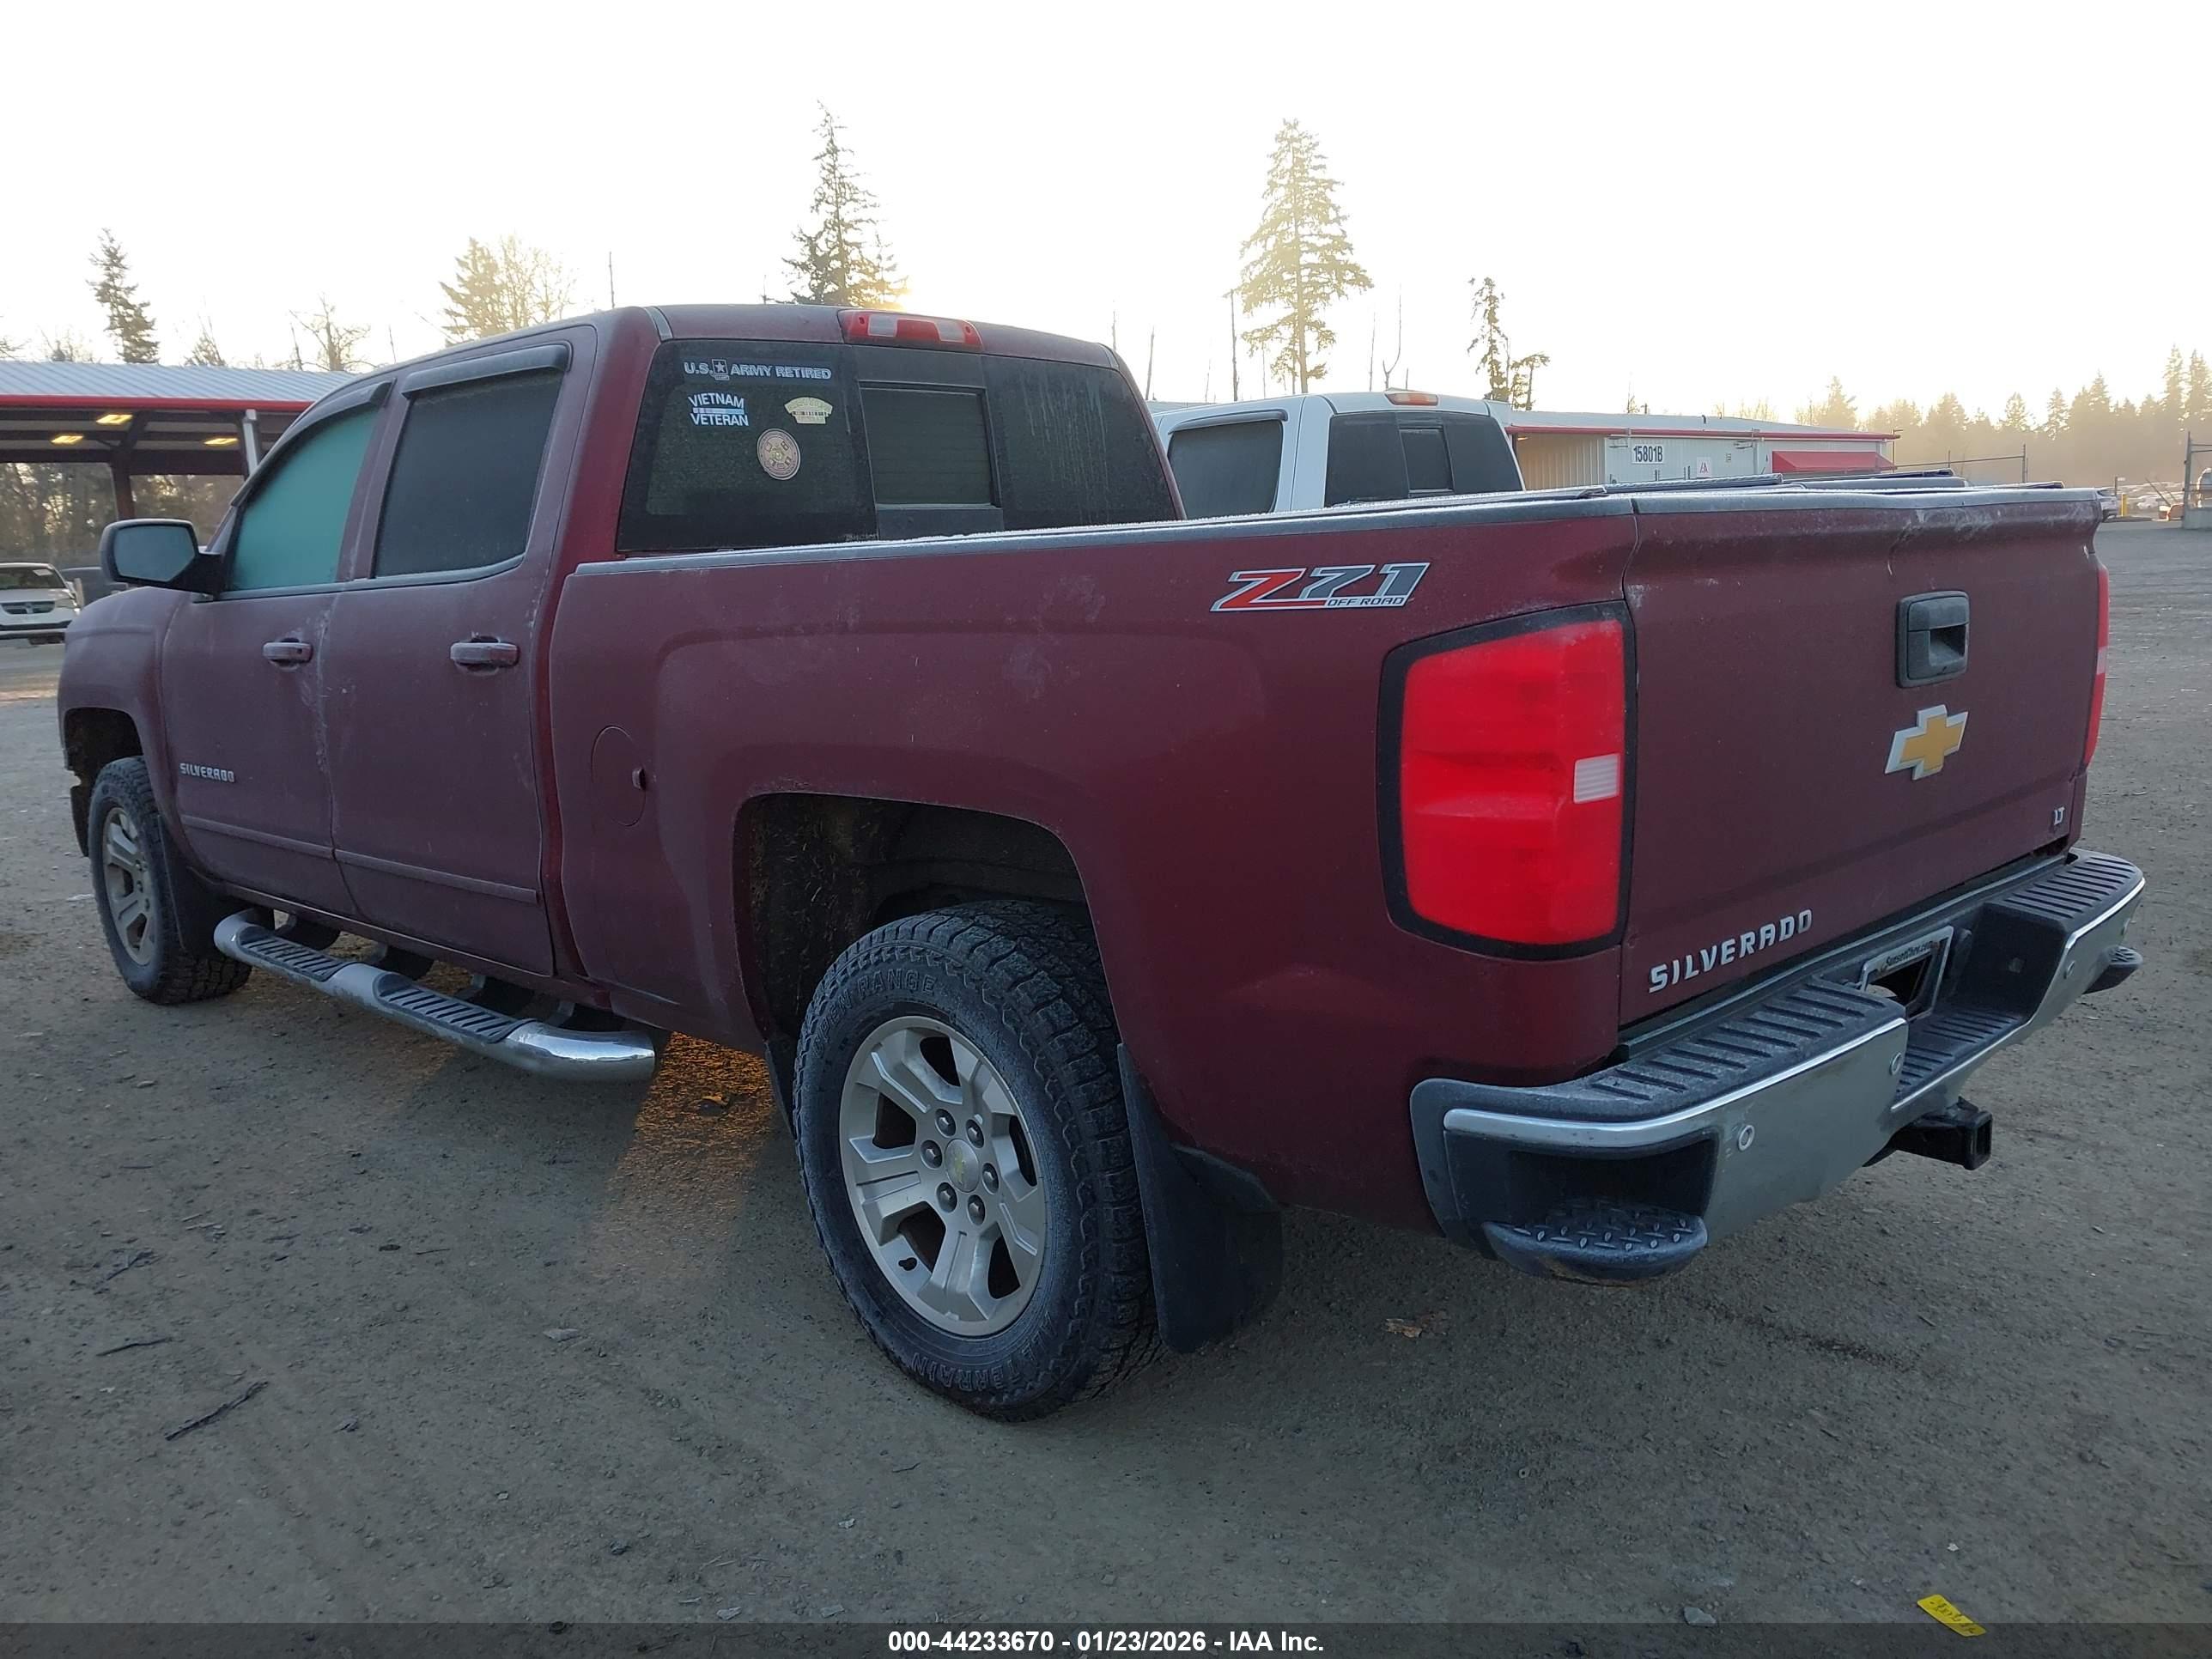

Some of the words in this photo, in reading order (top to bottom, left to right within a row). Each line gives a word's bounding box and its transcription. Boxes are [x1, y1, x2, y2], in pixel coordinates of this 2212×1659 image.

[684, 362, 713, 374] U.S.
[730, 363, 772, 378] ARMY
[775, 366, 832, 380] RETIRED
[688, 392, 744, 409] VIETNAM
[690, 412, 749, 426] VETERAN
[1633, 445, 1663, 463] 15801B
[1209, 562, 1431, 611] Z71
[179, 763, 234, 782] SILVERADO
[2053, 806, 2065, 826] LT
[1648, 908, 1813, 994] SILVERADO
[858, 968, 937, 999] RANGE
